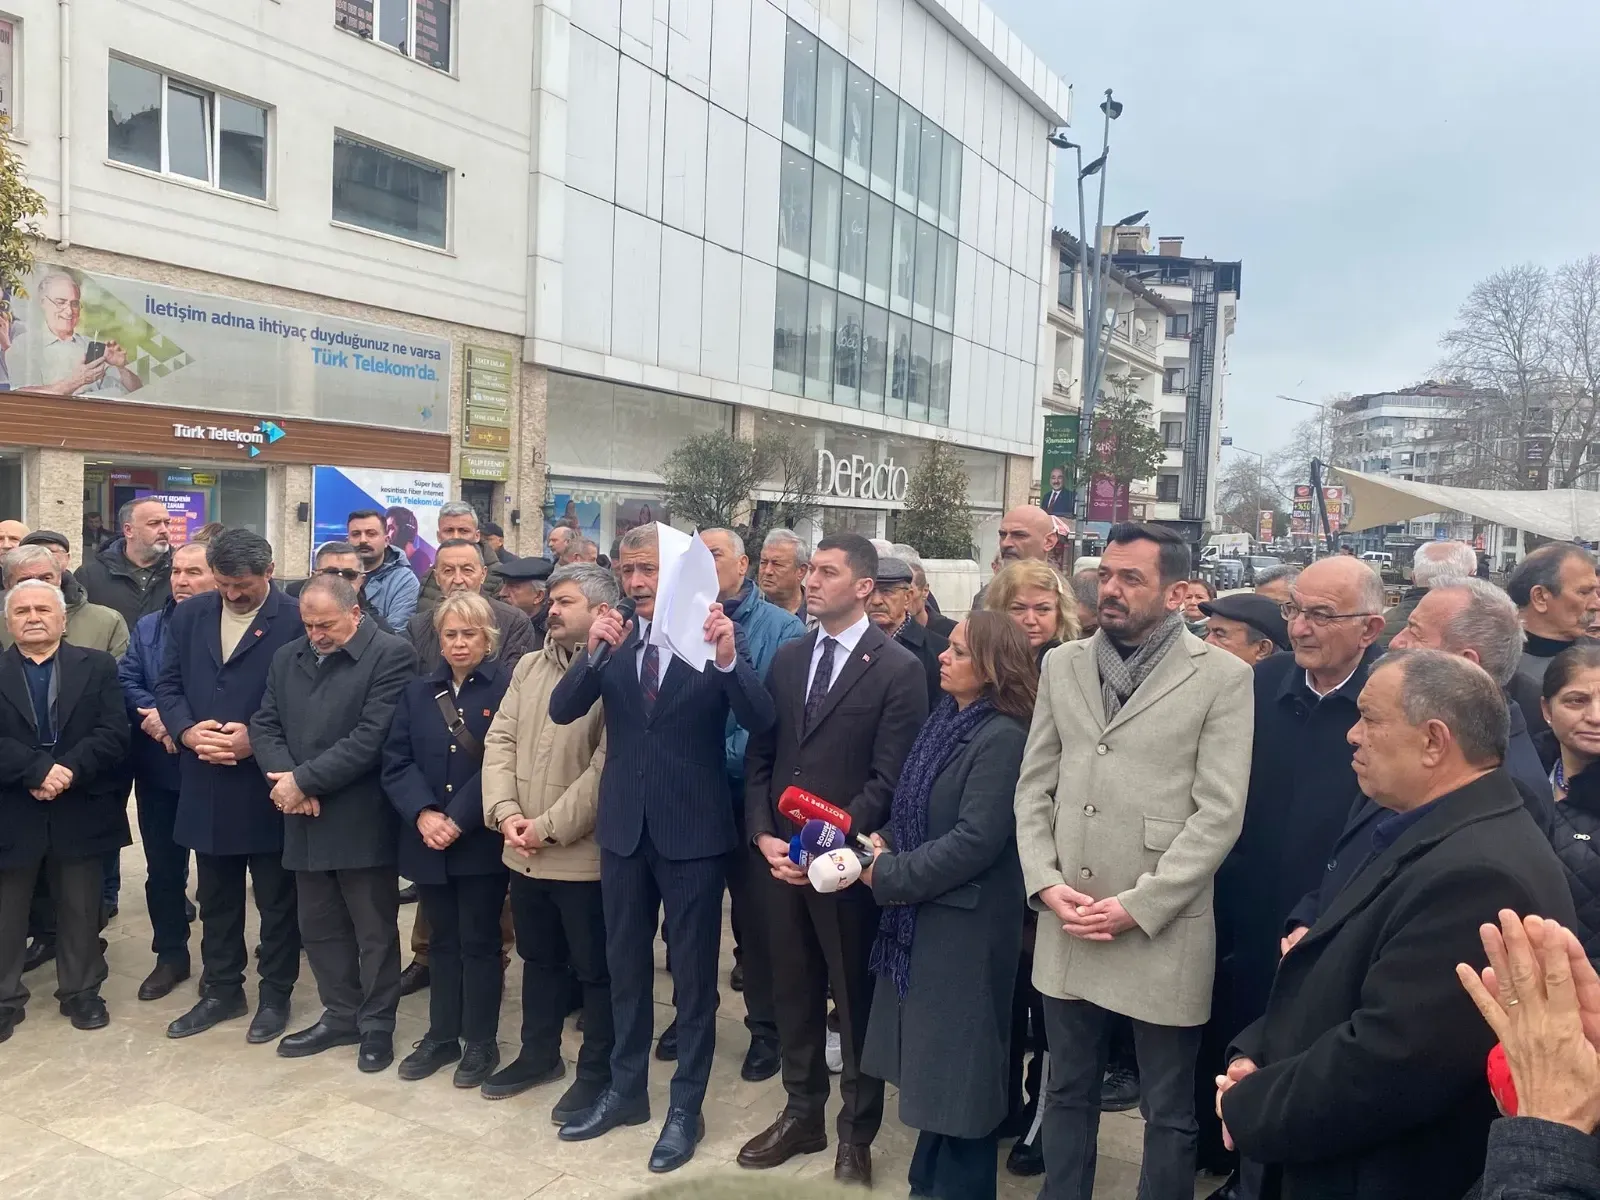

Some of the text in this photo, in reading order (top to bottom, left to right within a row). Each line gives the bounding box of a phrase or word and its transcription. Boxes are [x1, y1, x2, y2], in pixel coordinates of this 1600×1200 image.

[145, 294, 441, 361] İletişim adına ihtiyaç duyduğunuz ne varsa
[311, 347, 440, 382] Türk Telekom'da.
[172, 423, 264, 444] Türk Telekom
[816, 449, 909, 501] DeFacto
[380, 486, 444, 497] kesintisiz fiber internet
[414, 480, 430, 488] Süper
[385, 496, 402, 504] Türk
[799, 793, 810, 803] TV
